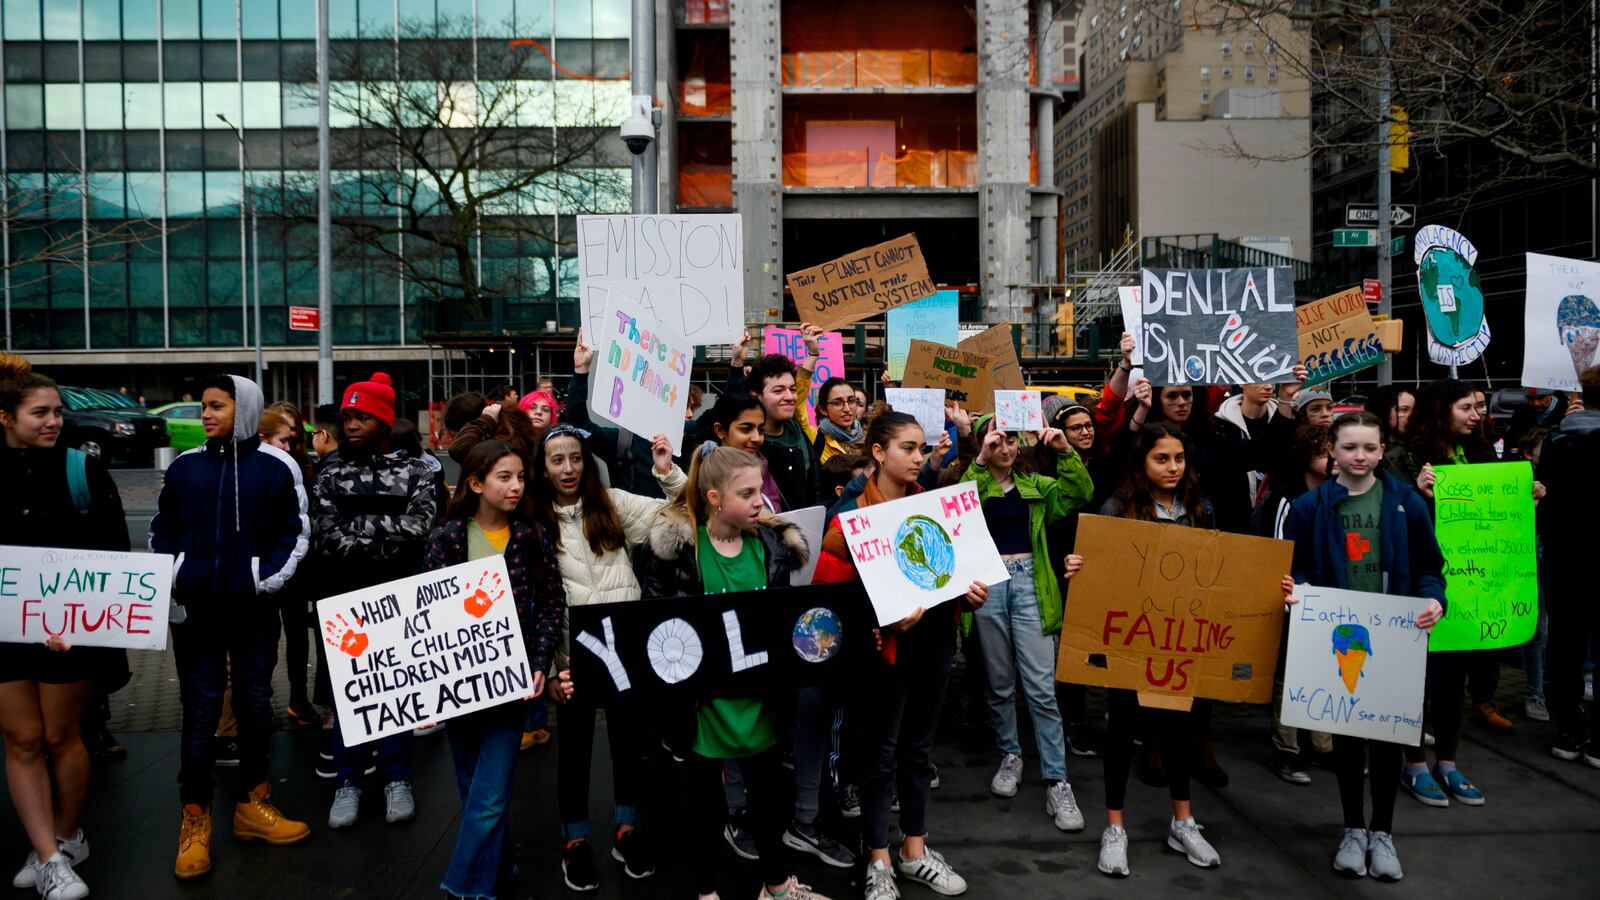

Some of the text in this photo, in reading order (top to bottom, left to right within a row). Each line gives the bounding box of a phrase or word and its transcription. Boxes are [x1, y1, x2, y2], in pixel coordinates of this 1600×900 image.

[1356, 211, 1374, 219] ONE
[581, 216, 738, 280] EMISSION
[1342, 232, 1345, 244] 1
[821, 255, 872, 284] PLANET
[874, 245, 915, 269] CANNOT
[1549, 263, 1581, 275] THERE
[812, 278, 876, 311] SUSTAIN
[873, 278, 935, 311] SYSTEM!
[1142, 267, 1294, 316] DENIAL
[1438, 287, 1454, 307] IS
[1568, 280, 1581, 290] NO
[1296, 303, 1325, 329] AISE
[616, 310, 667, 362] There
[936, 346, 960, 360] NEED
[1167, 338, 1220, 384] NOT
[1305, 339, 1379, 380] SEA LEVELS
[609, 376, 624, 418] B
[1435, 470, 1519, 497] Roses are red
[846, 489, 980, 563] I'M WITH HER
[1438, 501, 1523, 520] Children's tears are
[1474, 521, 1491, 531] blue
[1132, 542, 1226, 588] YOU
[1441, 542, 1454, 555] An
[0, 567, 158, 602] E WANT IS
[1442, 559, 1486, 577] Deaths
[1492, 564, 1509, 577] will
[22, 600, 153, 637] FUTURE
[351, 576, 460, 628] WHEN ADULTS
[1141, 596, 1203, 617] are
[1301, 595, 1423, 642] Earth is melt
[1488, 600, 1507, 619] will
[1512, 601, 1532, 617] YOU
[404, 609, 433, 640] ACT
[1102, 610, 1236, 653] FAILING
[1480, 620, 1507, 642] DO?
[351, 616, 510, 676] LIKE CHILDREN
[344, 634, 515, 703] CHILDREN MUST
[1146, 657, 1194, 691] US
[353, 662, 529, 736] TAKE ACTION
[1289, 687, 1308, 703] We
[1307, 688, 1360, 724] CAN
[1358, 710, 1375, 723] save
[1379, 714, 1391, 723] our
